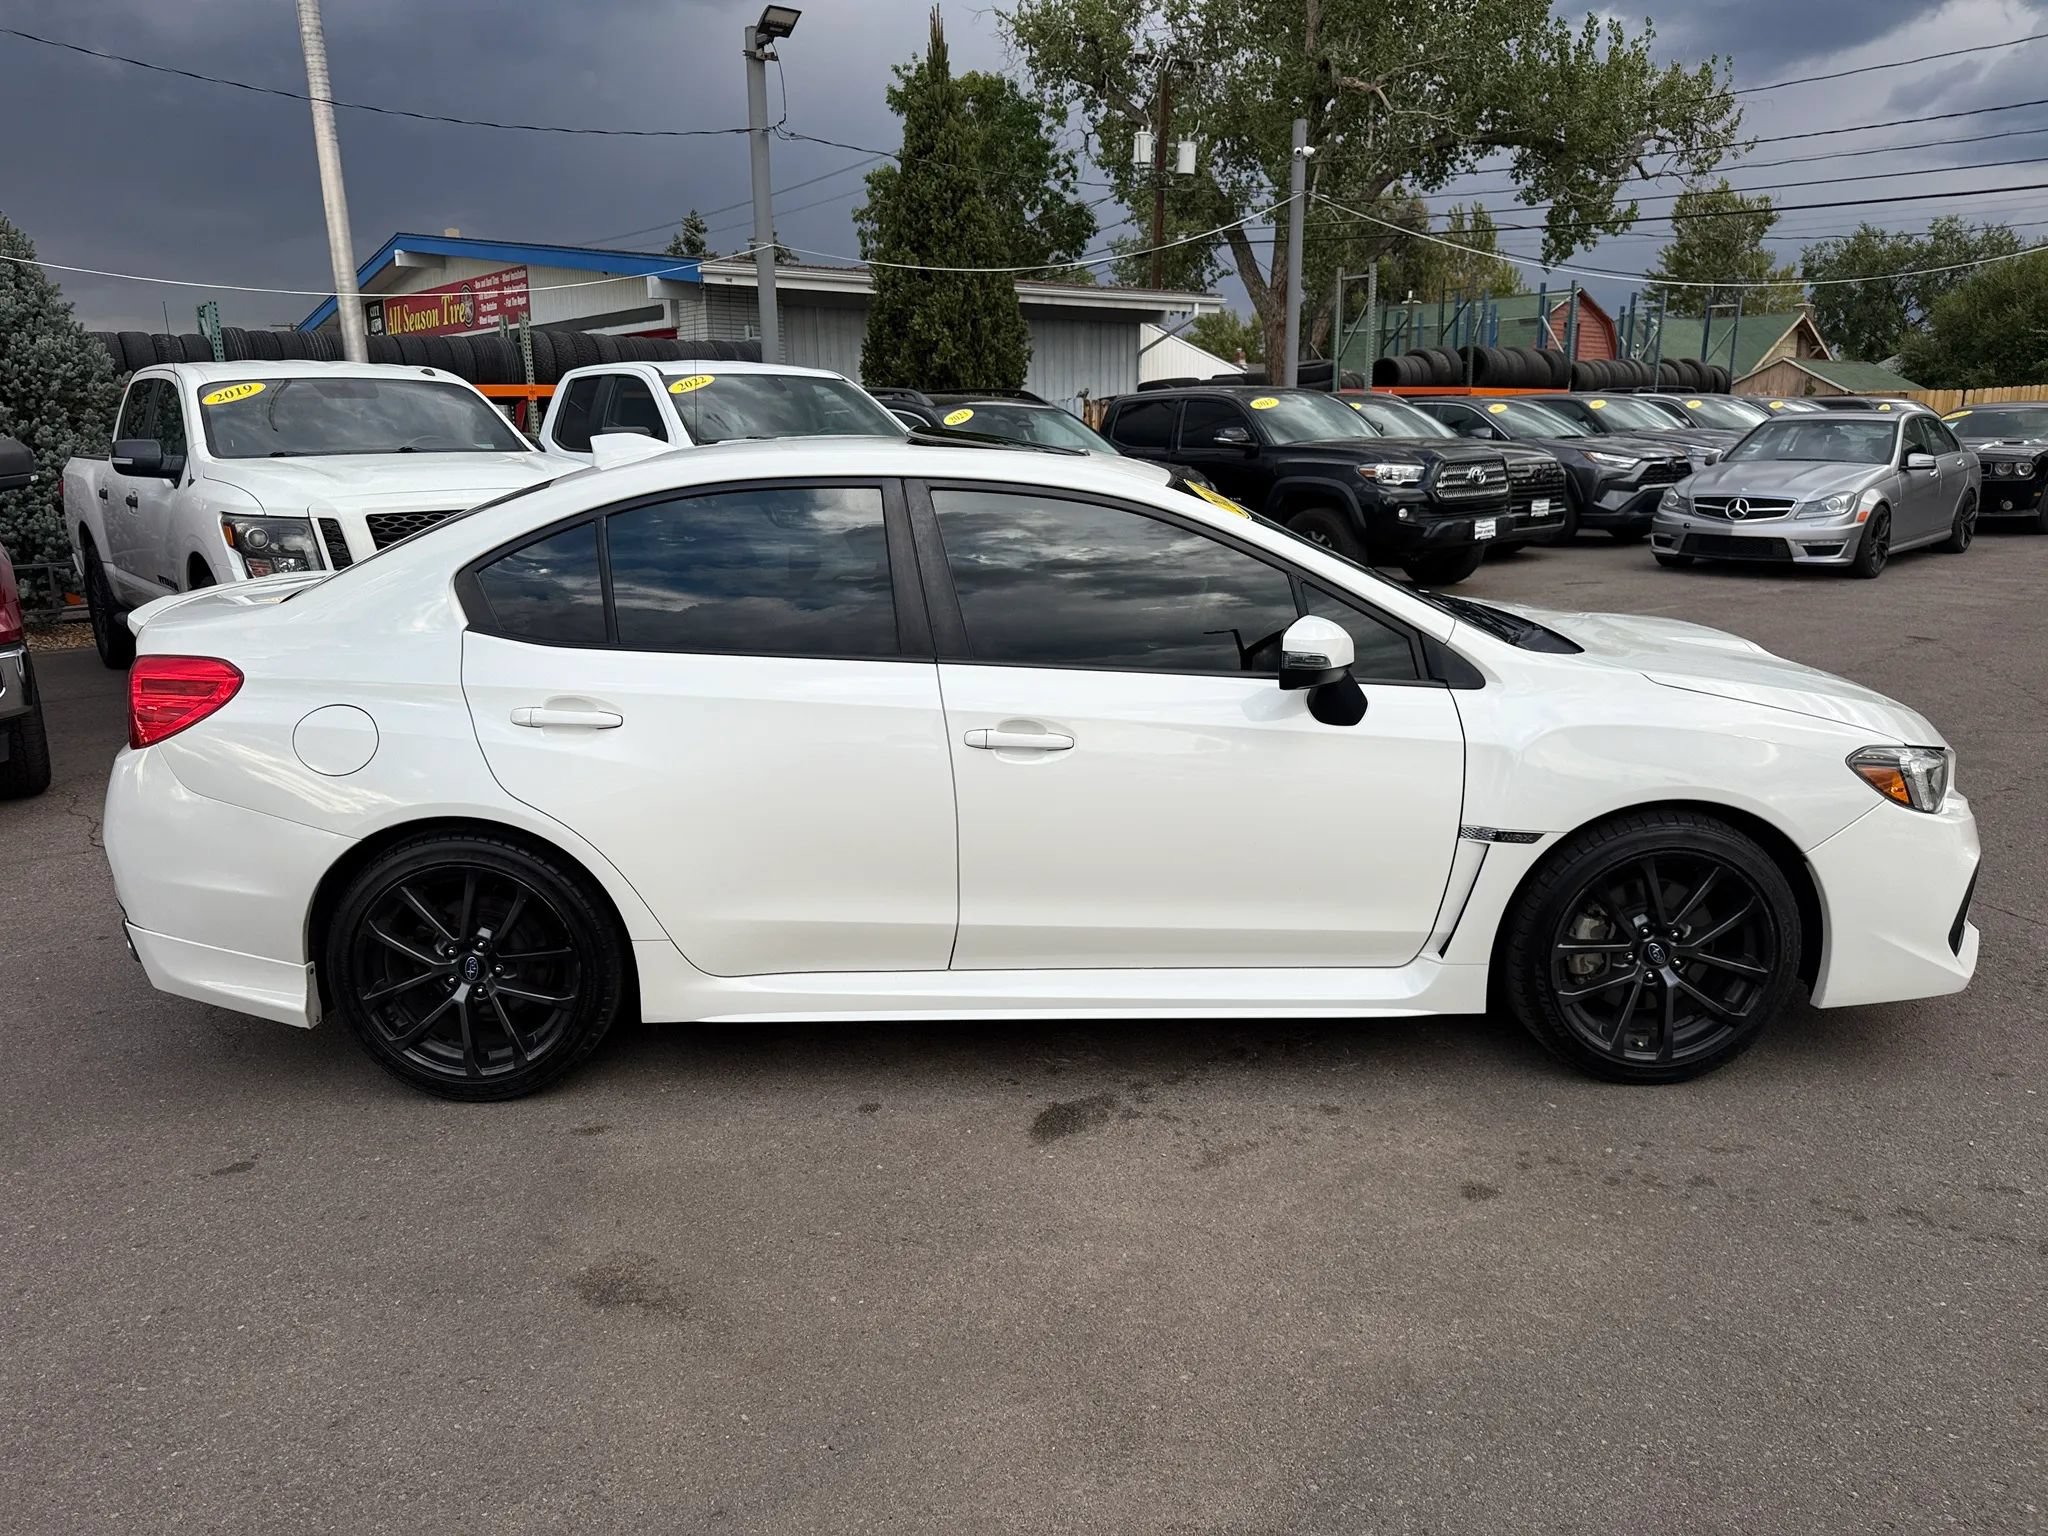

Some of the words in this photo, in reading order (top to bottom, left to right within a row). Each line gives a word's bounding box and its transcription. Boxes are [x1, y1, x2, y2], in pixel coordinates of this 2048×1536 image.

[388, 305, 402, 336] All
[403, 304, 439, 333] Season
[441, 294, 466, 325] Tire
[677, 376, 707, 391] 2022
[214, 384, 253, 402] 2019
[1500, 833, 1534, 842] WRX
